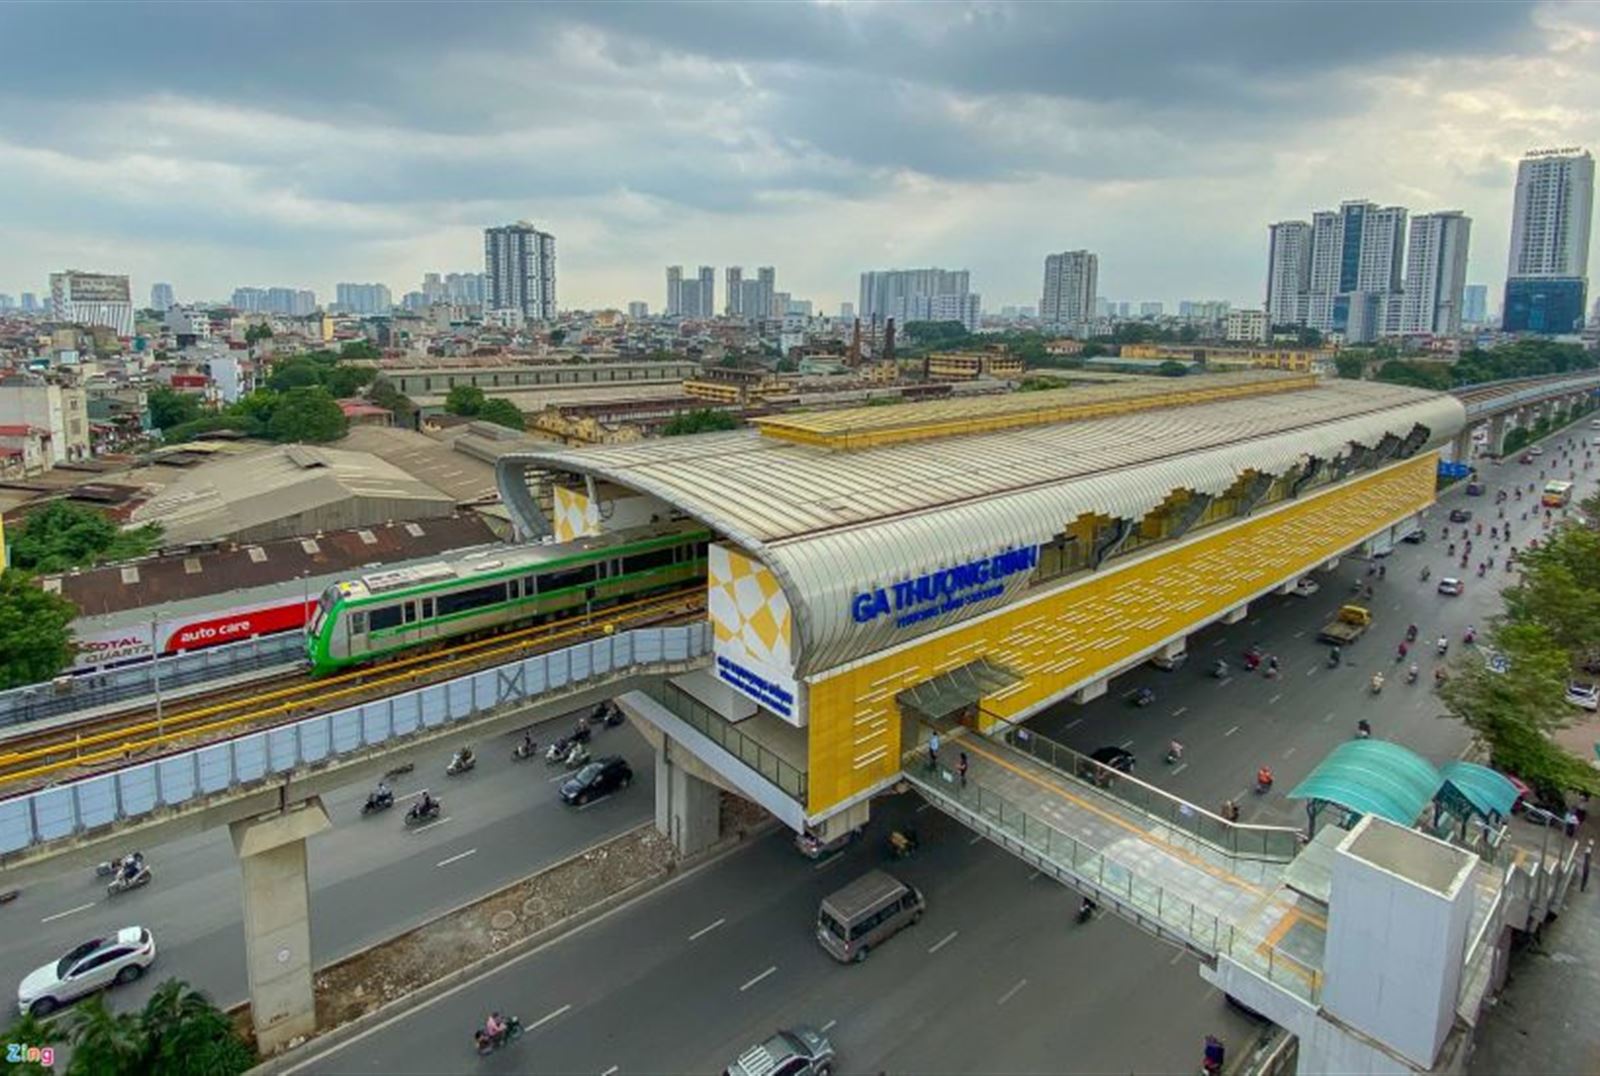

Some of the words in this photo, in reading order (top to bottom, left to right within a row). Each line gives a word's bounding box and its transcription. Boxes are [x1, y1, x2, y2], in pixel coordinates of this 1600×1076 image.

[852, 587, 891, 623] GA
[181, 627, 216, 642] auto
[219, 621, 250, 635] care
[85, 644, 152, 663] QUARTZ
